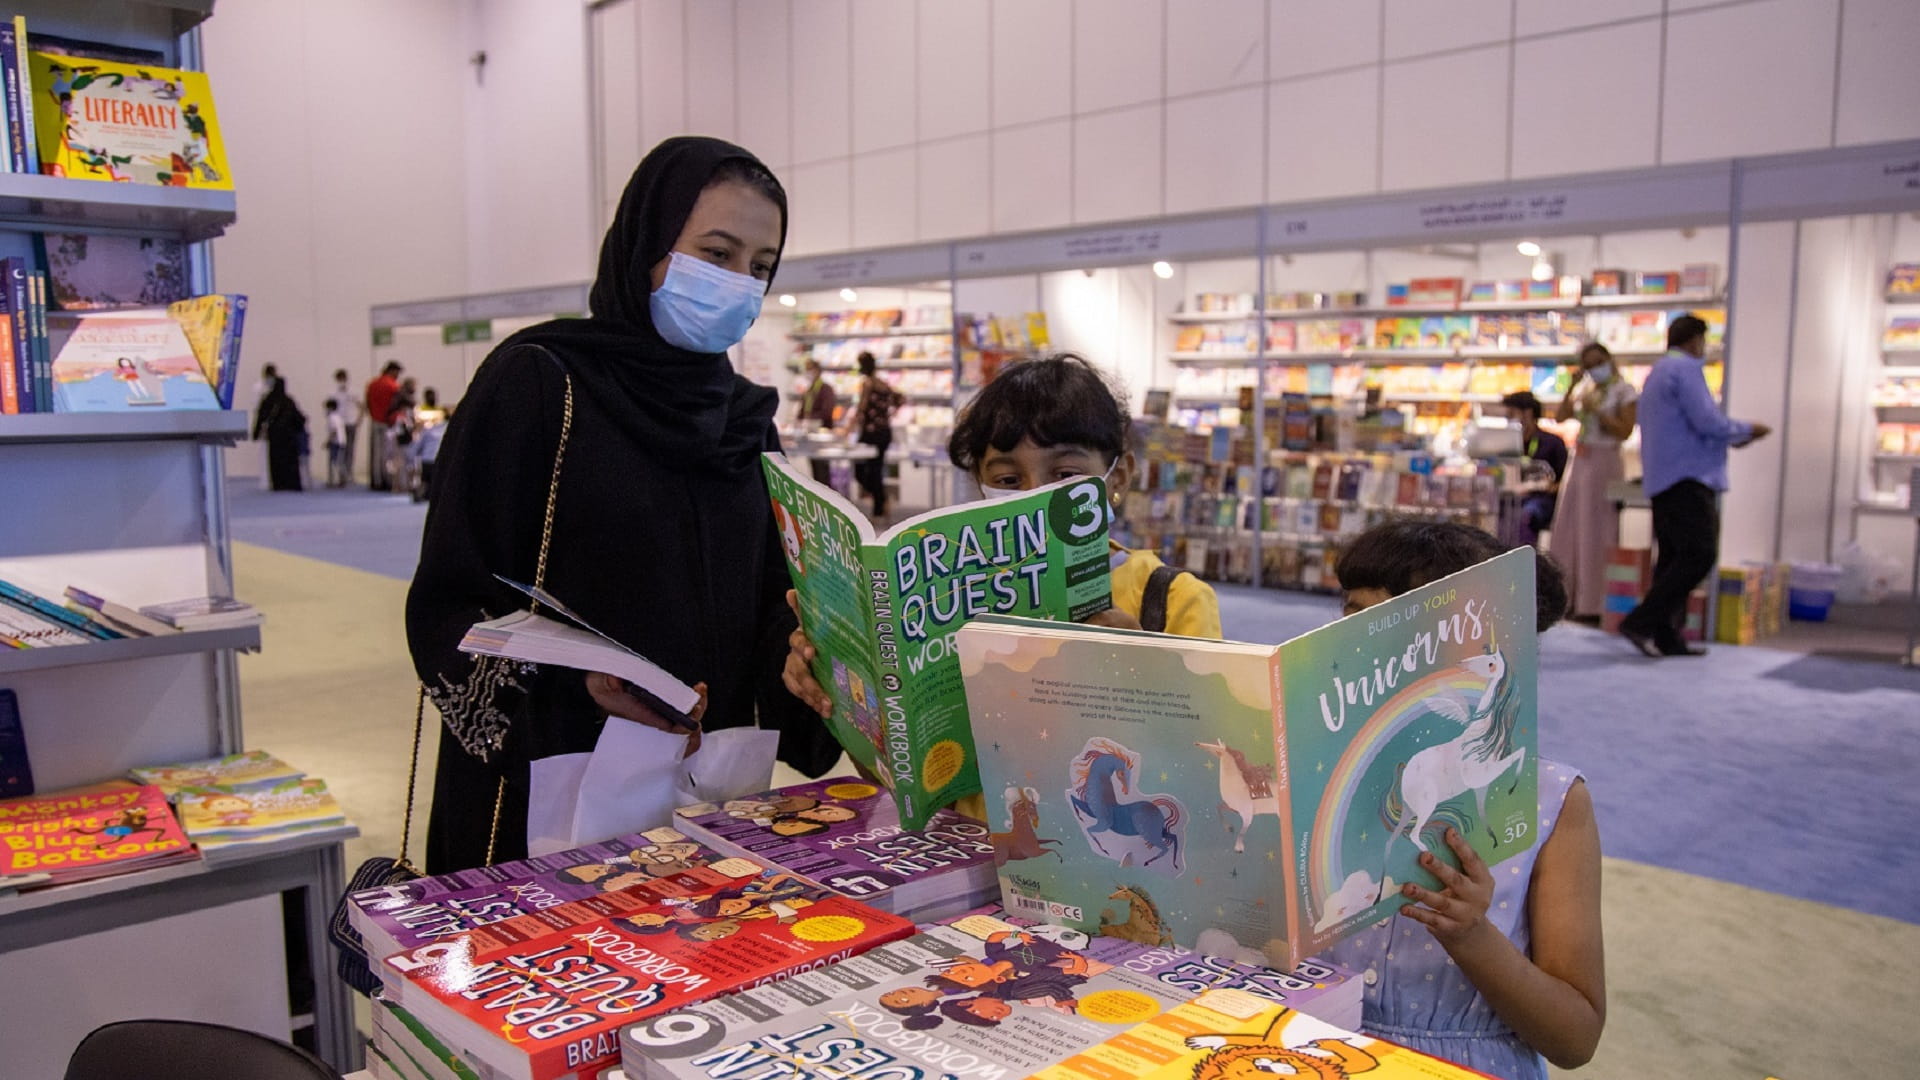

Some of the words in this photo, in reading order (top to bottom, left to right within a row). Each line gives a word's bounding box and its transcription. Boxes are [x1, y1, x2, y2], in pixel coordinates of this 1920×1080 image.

[85, 96, 176, 130] LITERALLY
[795, 490, 830, 533] FUN
[834, 514, 856, 552] TO
[1069, 482, 1103, 538] 3
[797, 515, 820, 549] BE
[821, 532, 866, 585] SMART
[896, 508, 1048, 595] BRAIN
[869, 570, 892, 618] BRAIN
[900, 561, 1048, 641] QUEST
[1367, 611, 1401, 637] BUILD
[1403, 605, 1420, 623] UP
[1423, 588, 1458, 613] YOUR
[877, 622, 899, 669] QUEST
[1318, 598, 1488, 733] Unicorns
[884, 695, 913, 783] WORKBOOK
[0, 790, 141, 818] Monkey
[4, 834, 97, 851] Blue
[11, 838, 181, 869] Bottom
[856, 823, 989, 864] QUEST
[1503, 822, 1528, 844] 3D
[881, 839, 995, 876] RAIN
[829, 875, 889, 895] 4
[388, 902, 465, 939] AIN
[448, 892, 526, 926] EST
[504, 944, 665, 1014] QUEST
[571, 926, 712, 993] WORKBOOK
[1231, 960, 1335, 1001] BRA
[461, 960, 603, 1040] BRAIN
[567, 1026, 621, 1068] BRAI
[629, 1013, 711, 1046] 6
[761, 1023, 897, 1080] EST
[829, 1001, 1006, 1080] WORKBOOK
